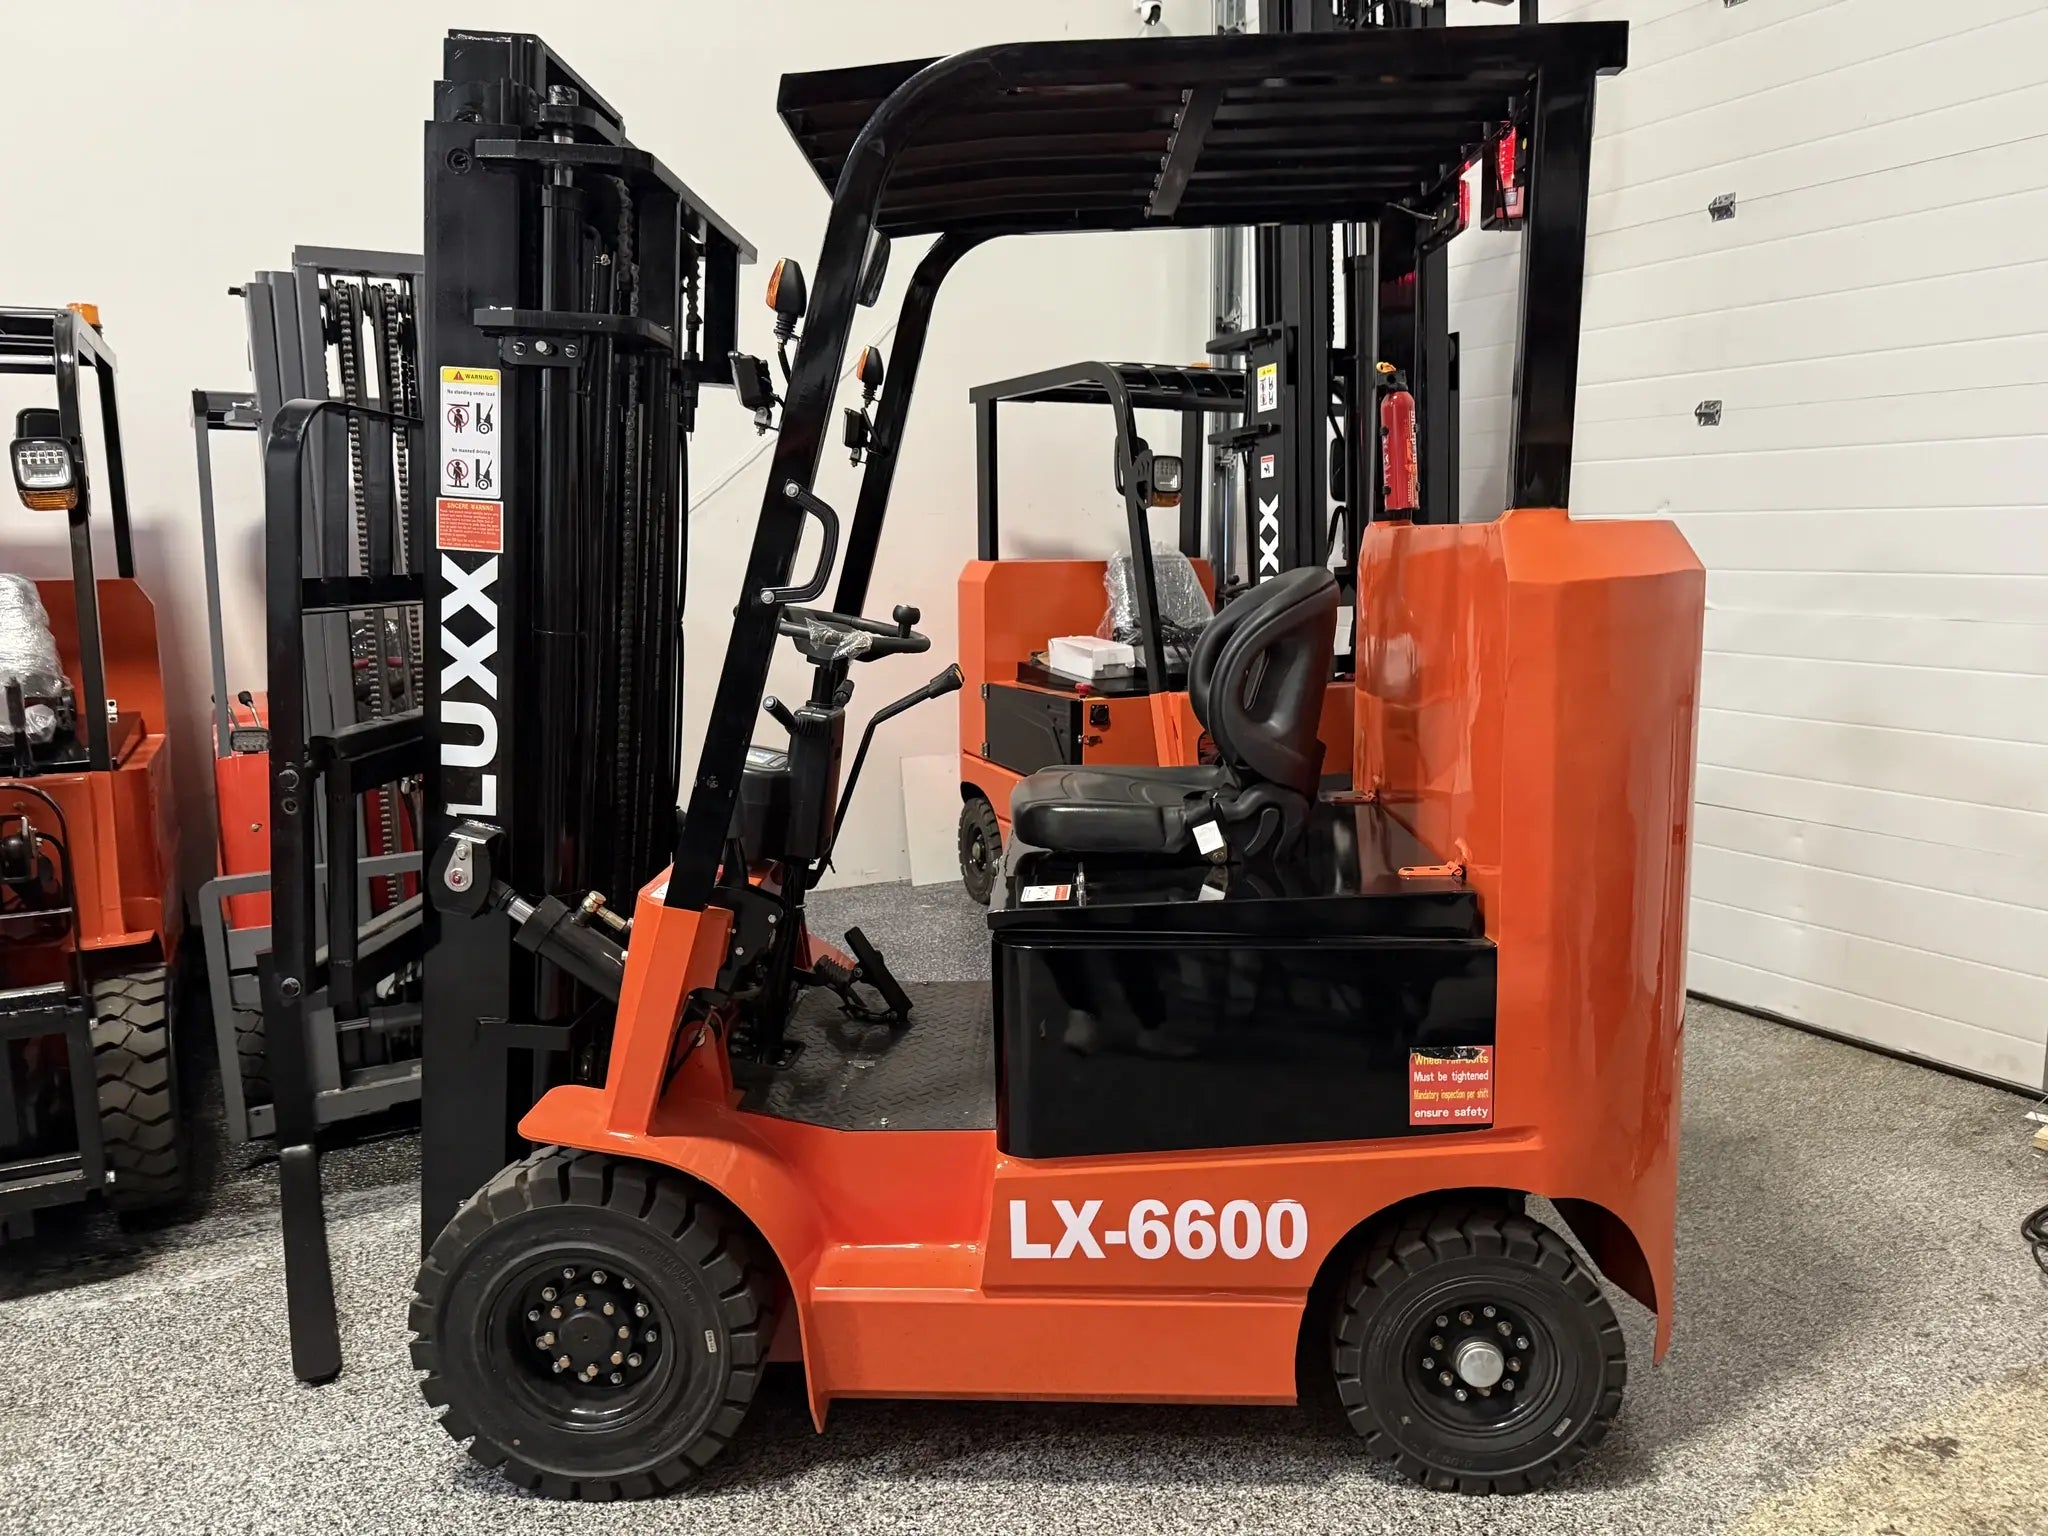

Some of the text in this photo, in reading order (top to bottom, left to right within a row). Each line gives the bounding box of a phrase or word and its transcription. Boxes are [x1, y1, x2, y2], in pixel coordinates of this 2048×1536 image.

[465, 373, 494, 381] WARNING
[440, 552, 499, 818] LUXX
[1413, 1070, 1489, 1083] Must be tightened
[1413, 1089, 1439, 1102] Mandatory
[1440, 1088, 1466, 1102] inspection
[1466, 1091, 1475, 1101] per
[1414, 1105, 1489, 1118] ensure safety
[1009, 1198, 1309, 1260] LX-6600
